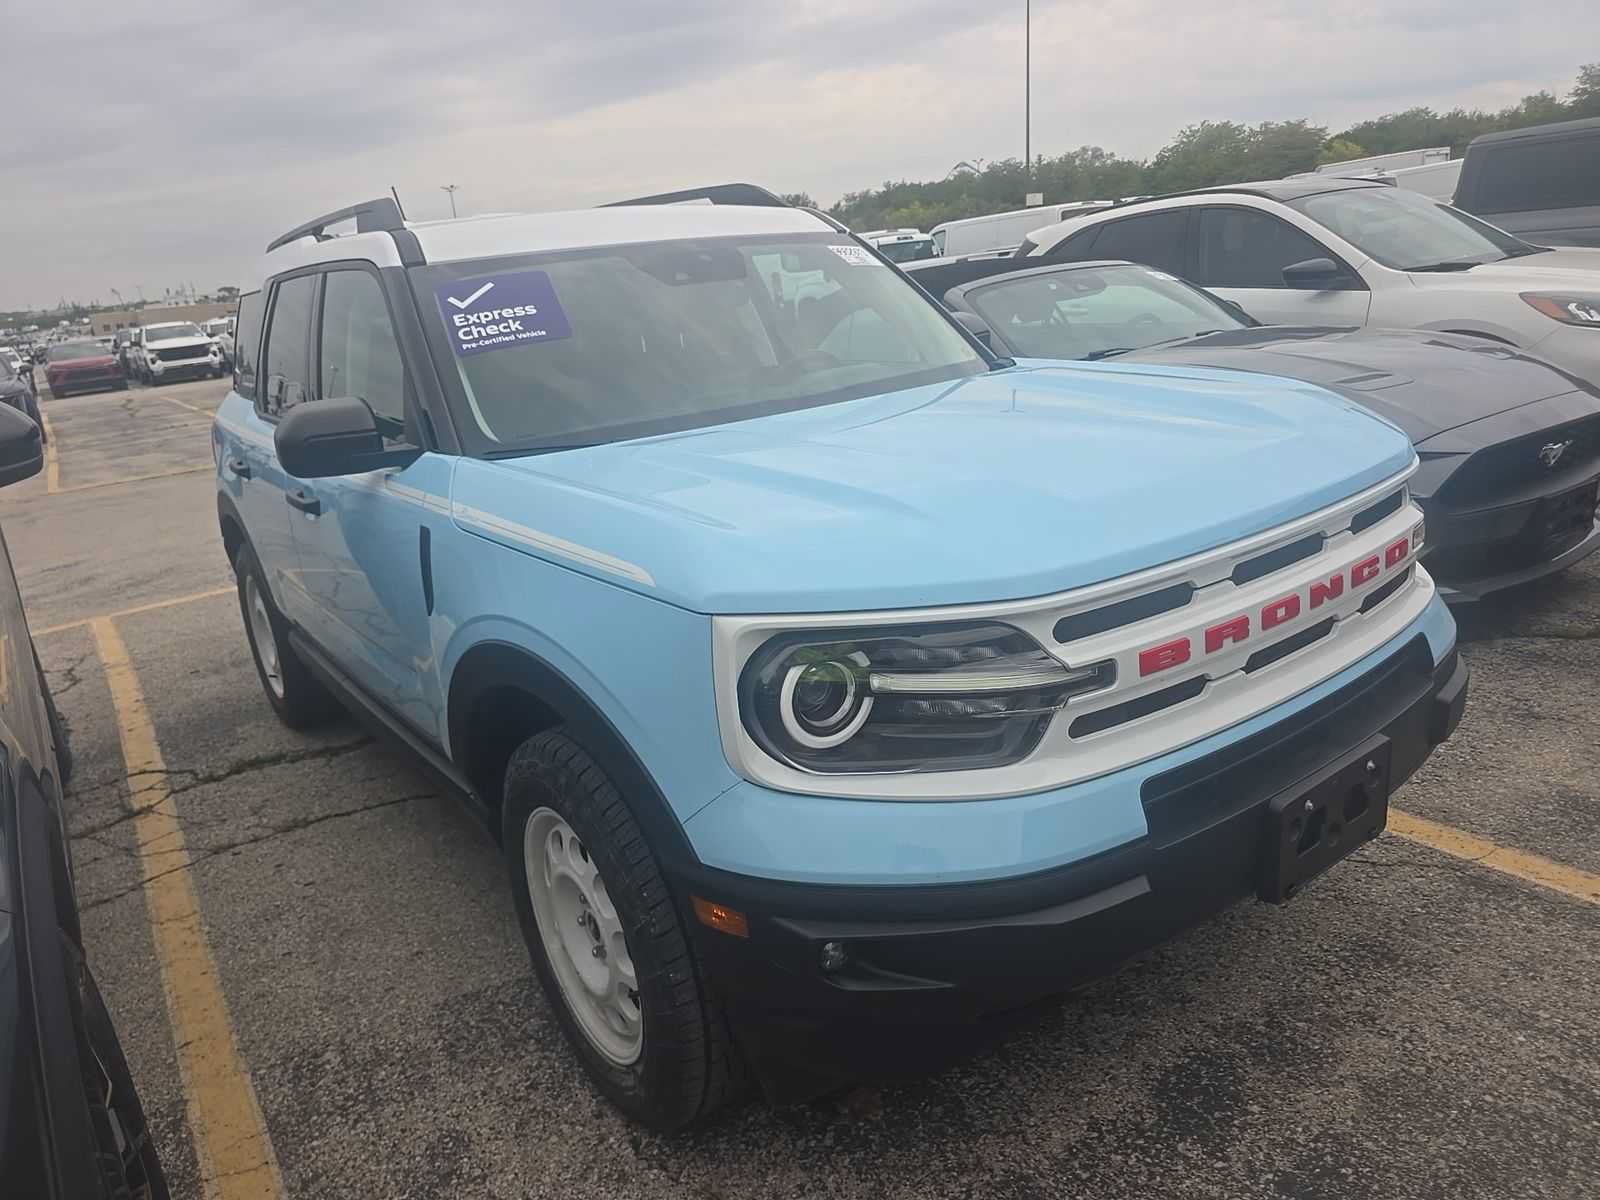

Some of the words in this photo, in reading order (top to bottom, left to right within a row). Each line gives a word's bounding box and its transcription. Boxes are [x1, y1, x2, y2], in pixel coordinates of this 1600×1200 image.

[453, 305, 537, 327] Express
[458, 319, 524, 340] Check
[461, 334, 515, 350] Pre-Certified
[516, 329, 546, 339] Vehicle
[1139, 538, 1409, 677] BRONCO
